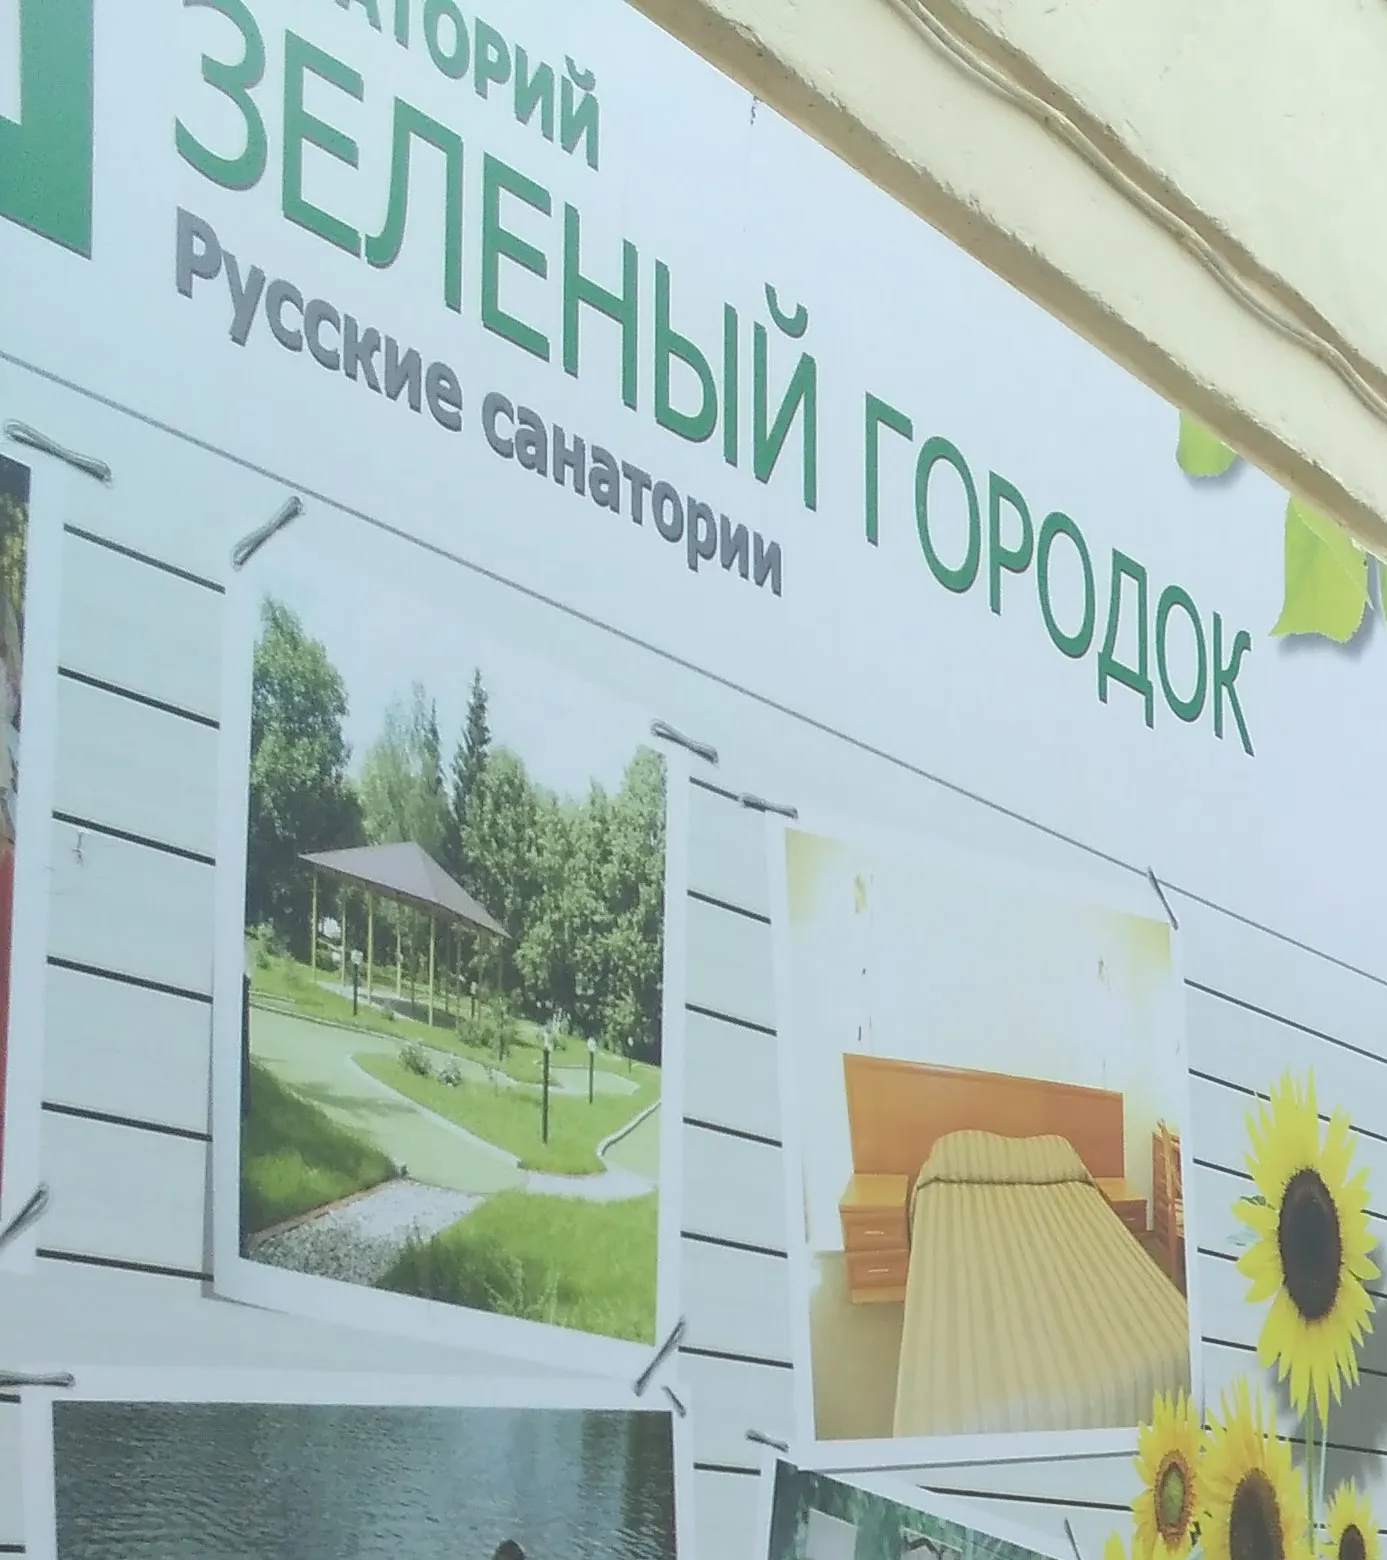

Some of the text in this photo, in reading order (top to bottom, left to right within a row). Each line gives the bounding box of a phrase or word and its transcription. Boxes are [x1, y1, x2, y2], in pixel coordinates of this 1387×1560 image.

[175, 0, 1255, 757] ЗЕЛЕНЫЙ ГОРОДОК
[176, 206, 783, 597] Русские санатории
